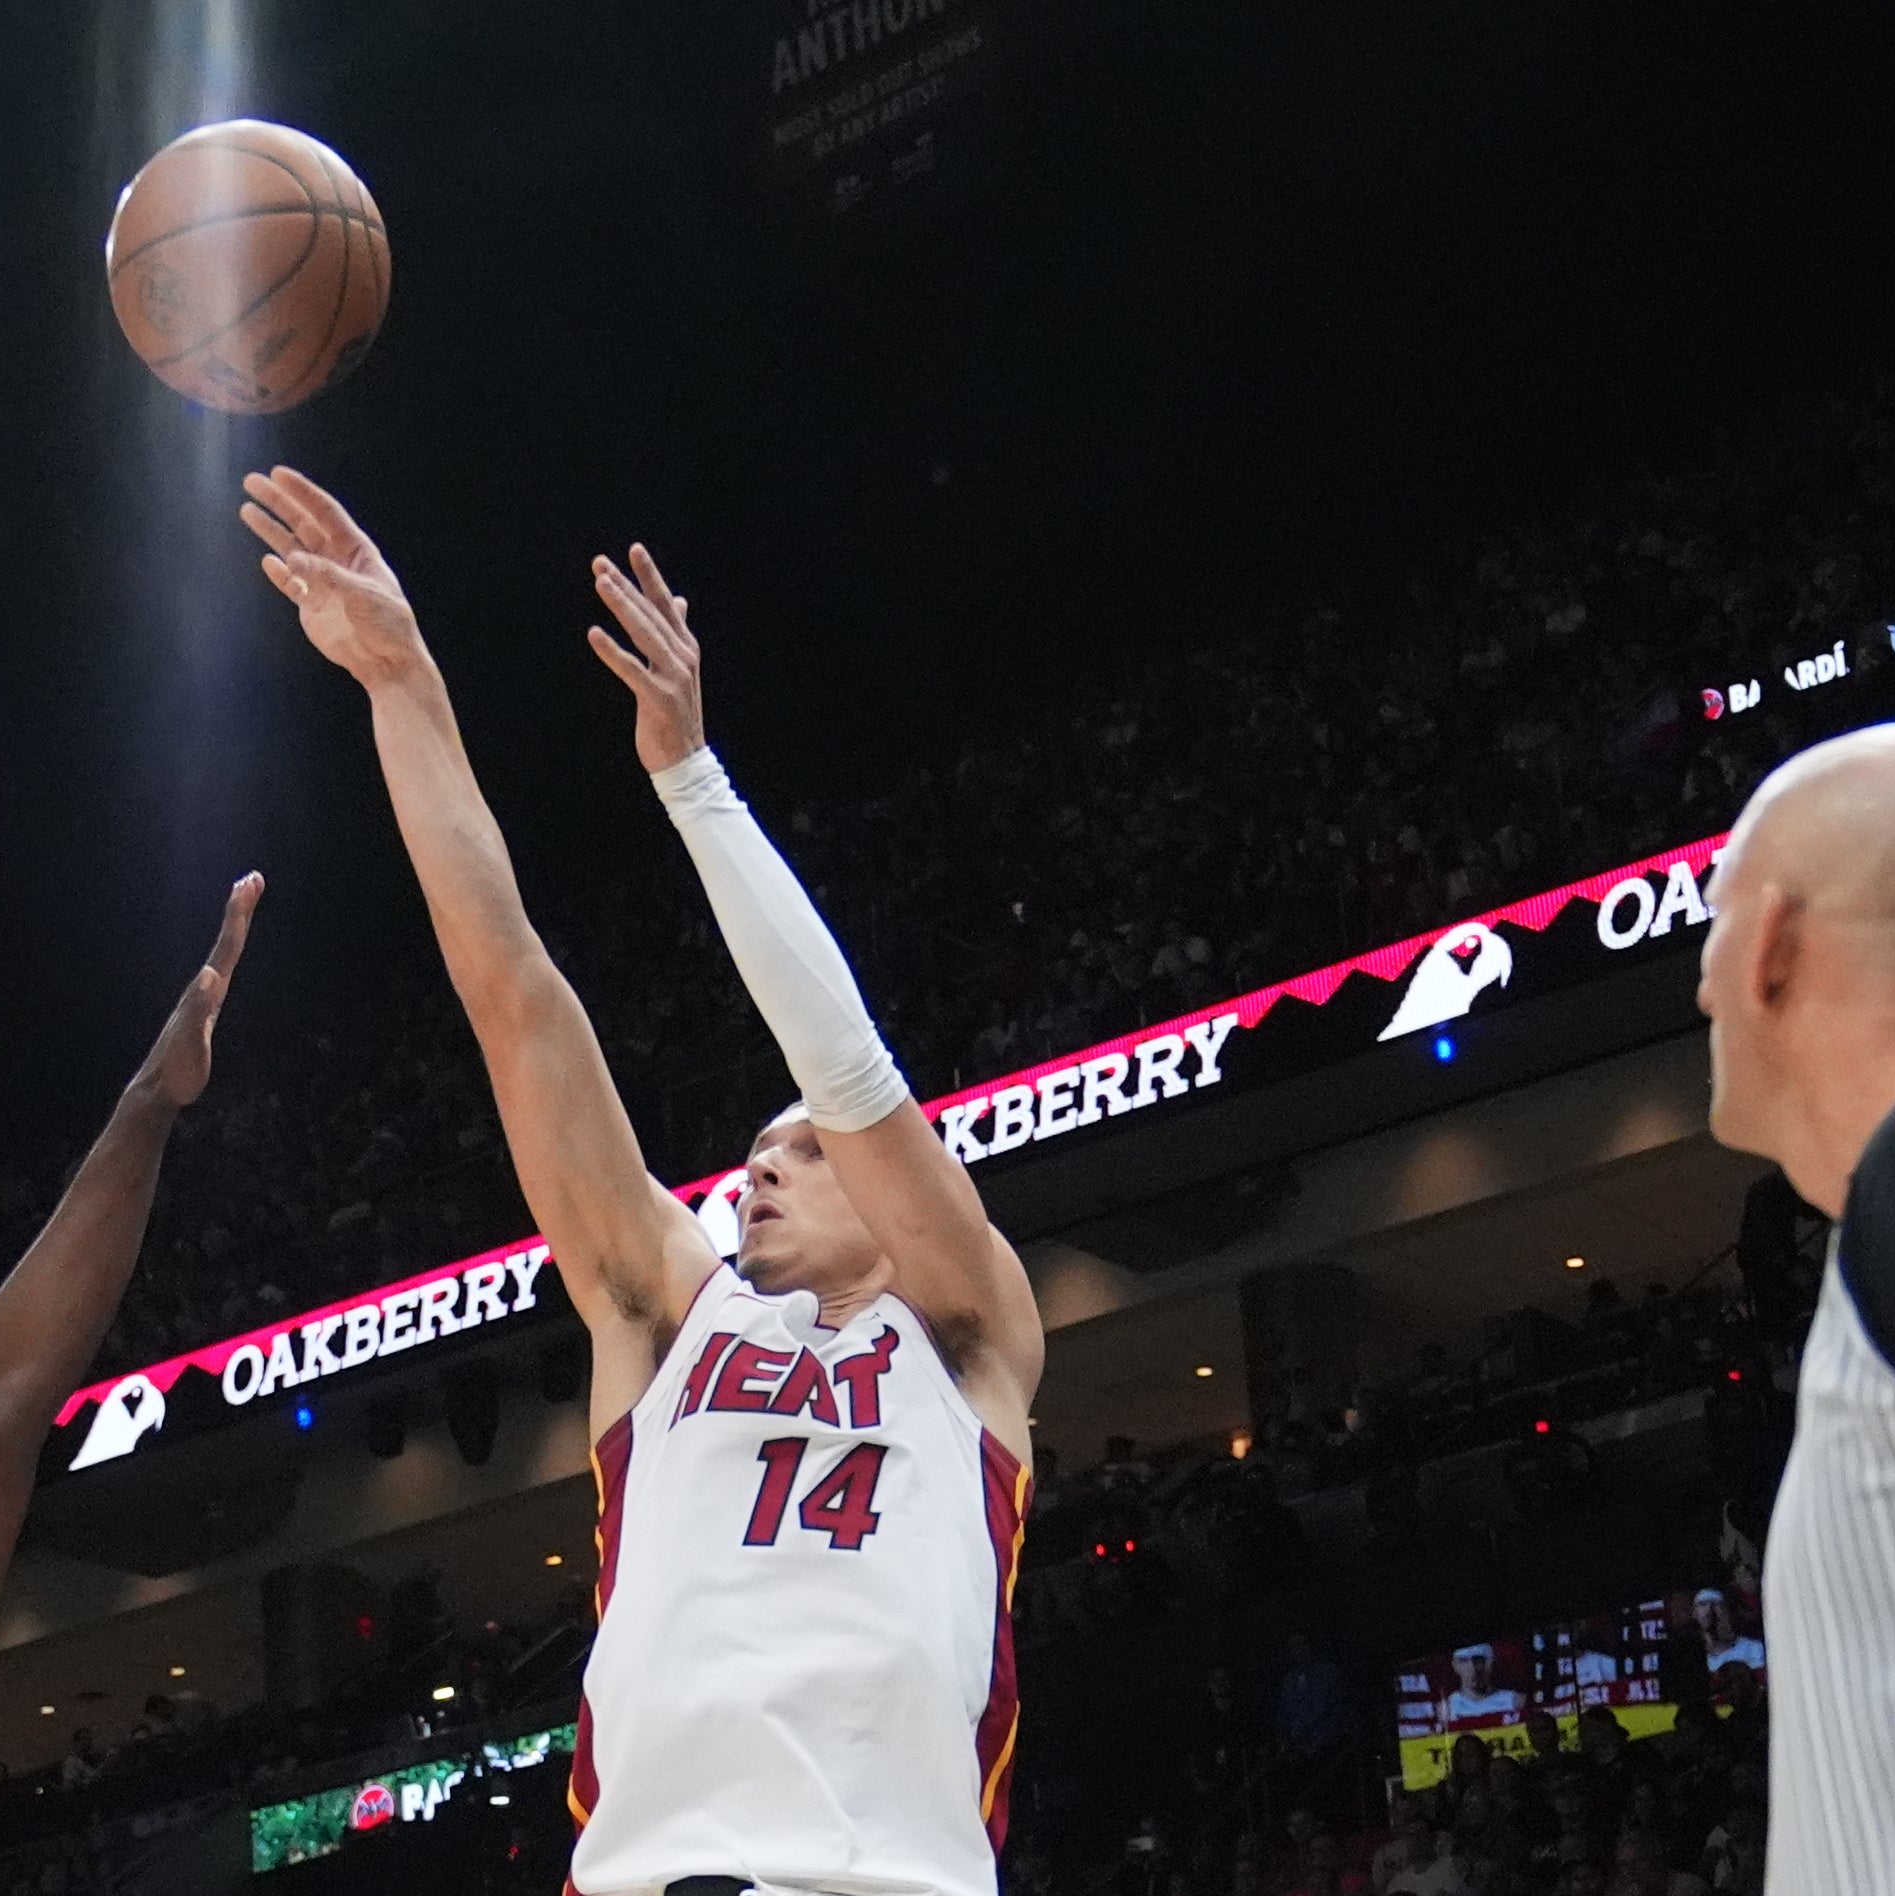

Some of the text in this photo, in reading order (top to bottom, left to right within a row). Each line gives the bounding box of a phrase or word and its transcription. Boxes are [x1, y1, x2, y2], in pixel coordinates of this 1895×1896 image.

[940, 1012, 1239, 1165] KBERRY
[222, 1261, 551, 1406] OAKBERRY
[741, 1436, 890, 1552] 14
